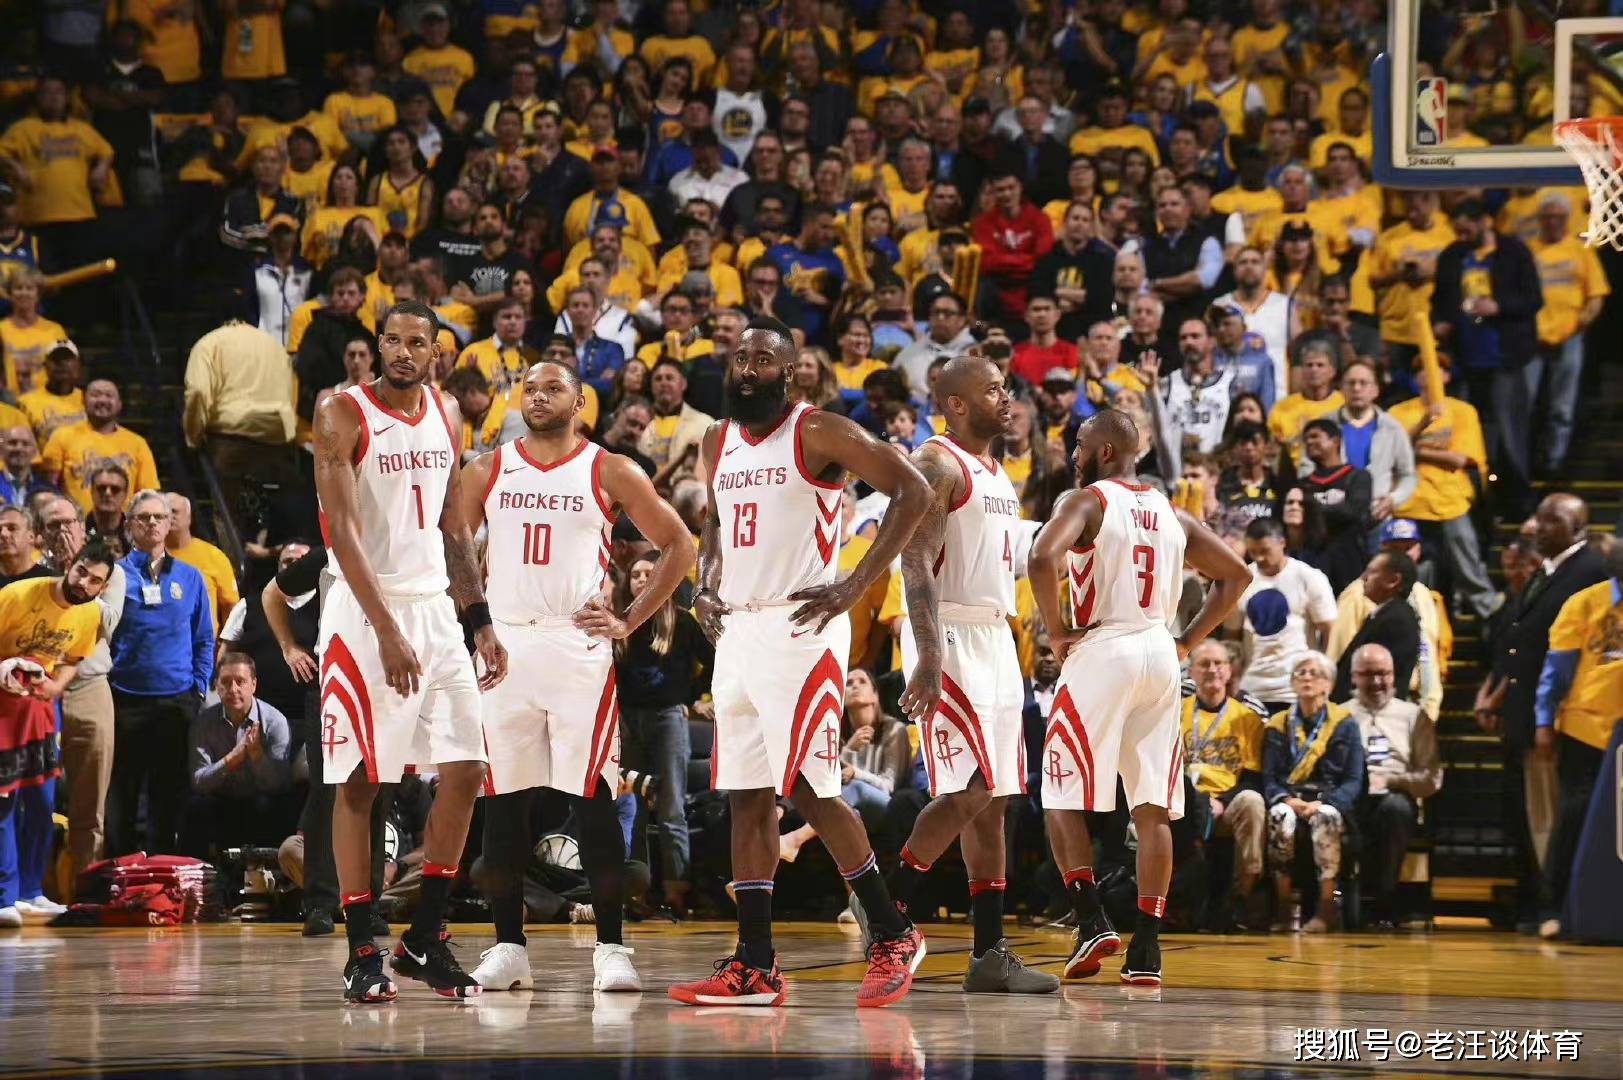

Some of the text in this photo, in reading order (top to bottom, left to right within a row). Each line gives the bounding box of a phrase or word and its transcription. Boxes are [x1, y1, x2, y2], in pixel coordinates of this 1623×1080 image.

[376, 450, 448, 474] ROCKETS
[717, 466, 787, 492] ROCKETS
[411, 484, 425, 530] 1
[499, 490, 584, 512] ROCKETS
[982, 494, 1018, 516] ROCKET
[522, 522, 552, 566] 10
[733, 502, 758, 549] 13
[1002, 529, 1013, 572] 4
[1132, 544, 1155, 609] 3
